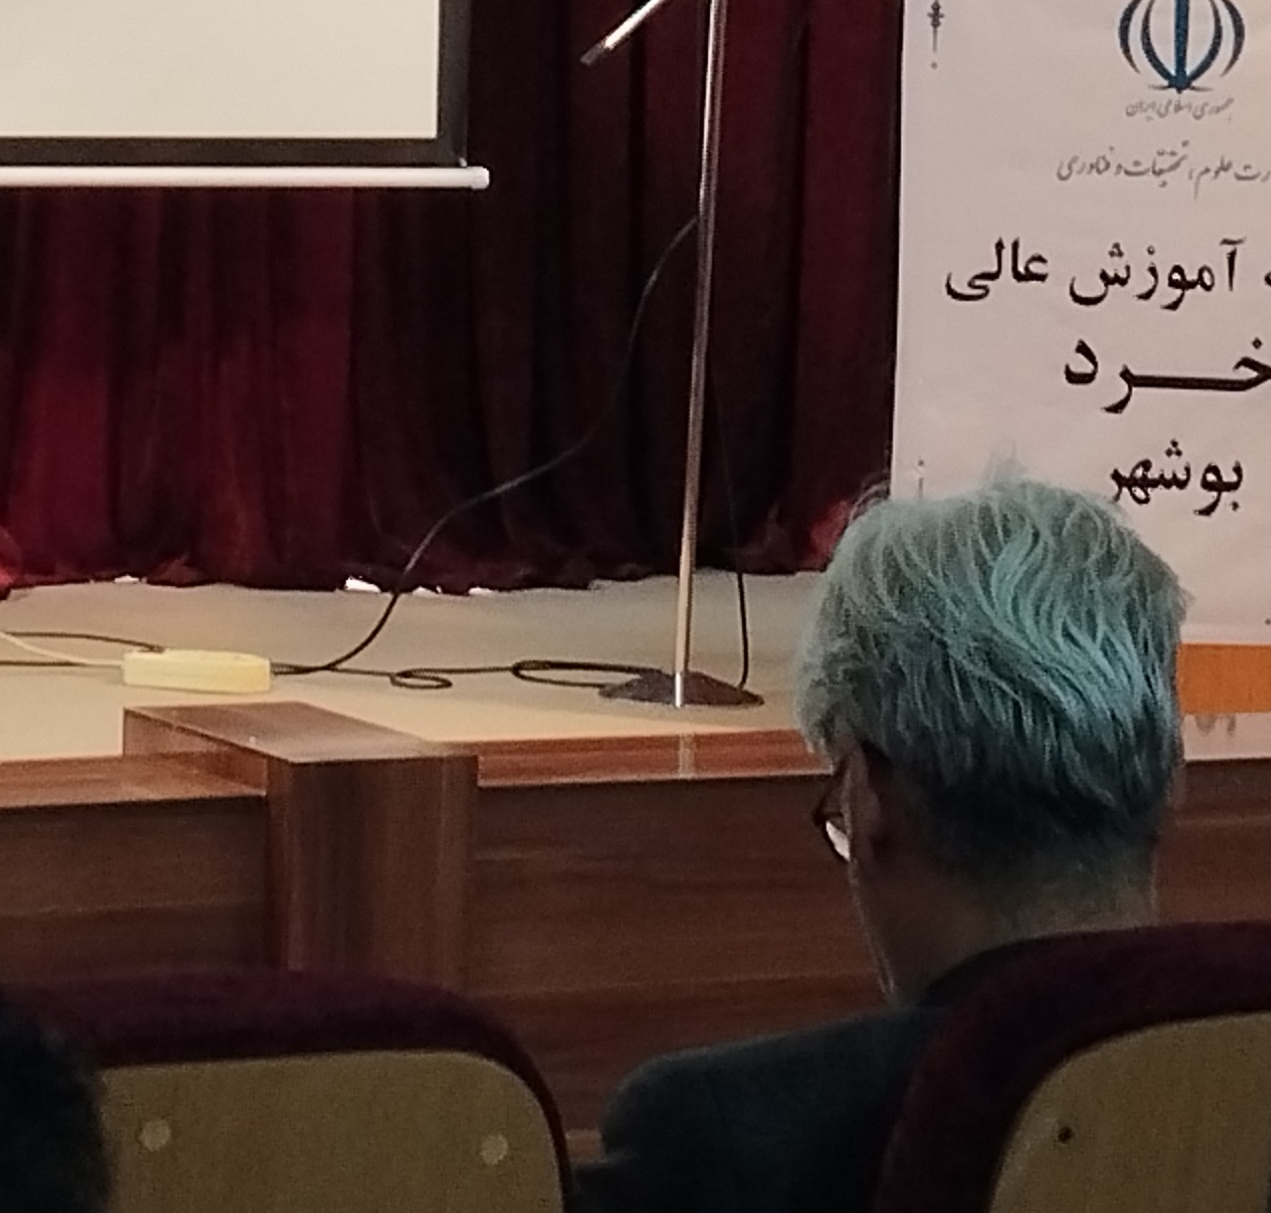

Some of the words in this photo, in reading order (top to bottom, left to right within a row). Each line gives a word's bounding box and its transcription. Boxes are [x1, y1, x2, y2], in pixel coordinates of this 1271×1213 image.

[1056, 145, 1115, 181] فناوری
[945, 236, 1050, 302] عالی
[1069, 236, 1248, 311] آموزش
[1107, 438, 1245, 517] بوشهر
